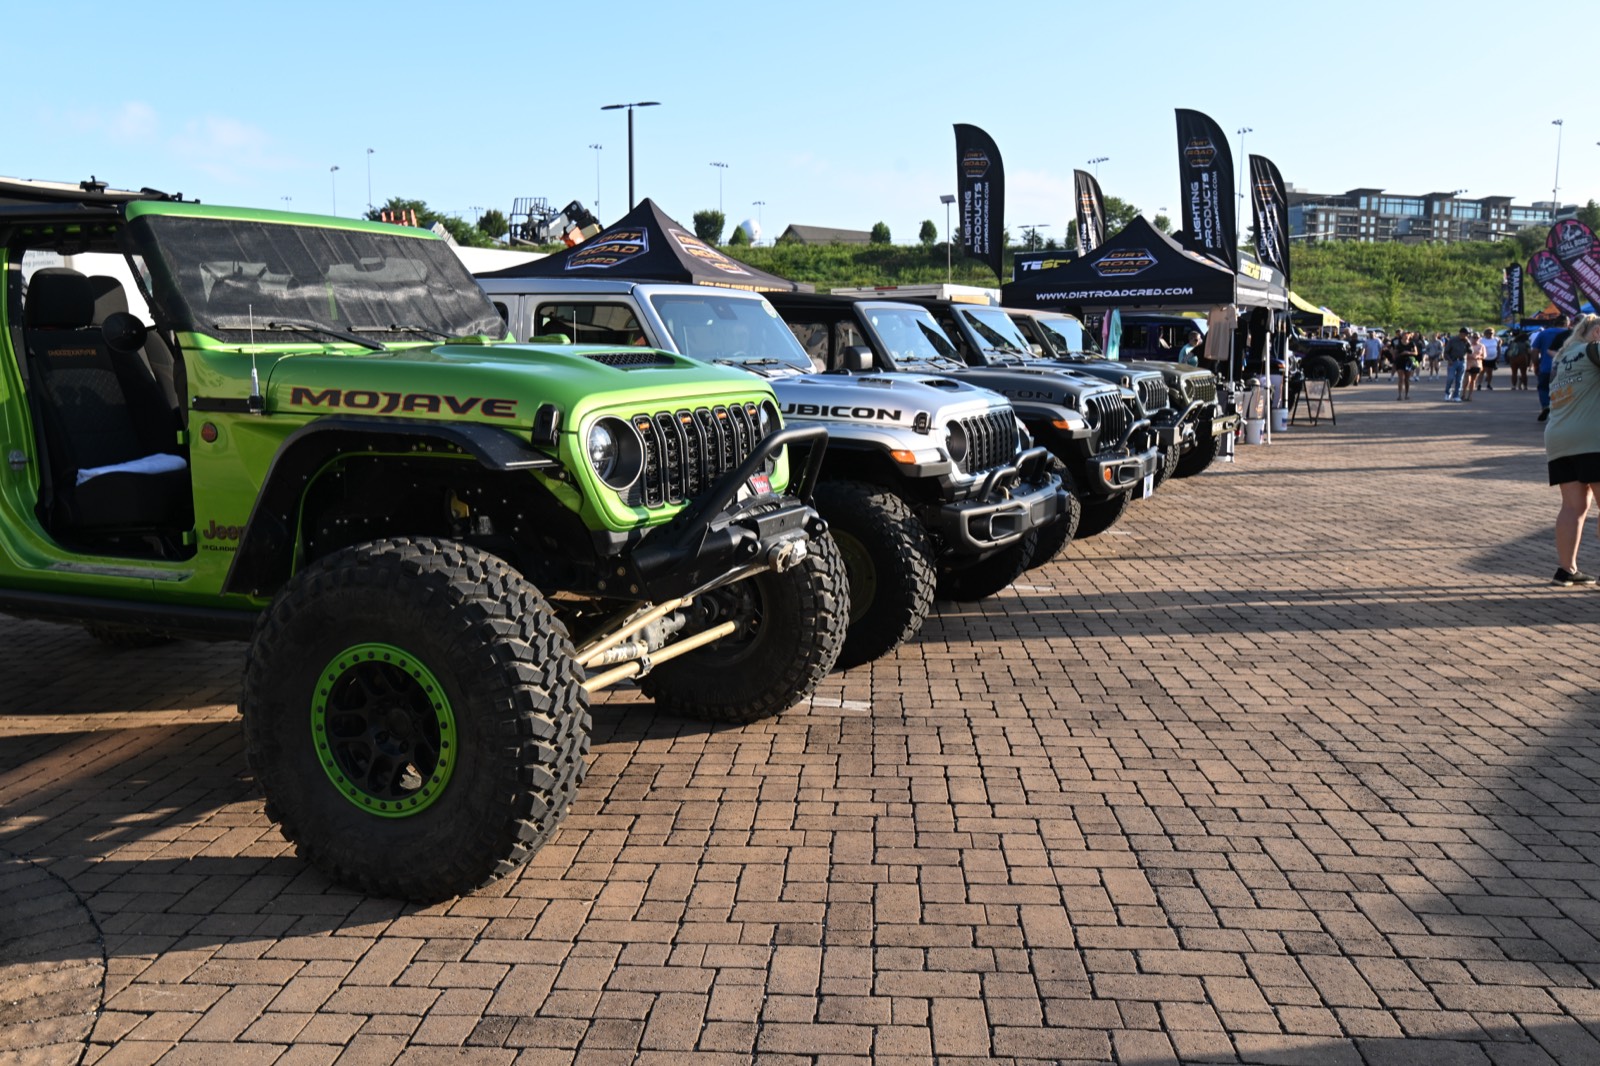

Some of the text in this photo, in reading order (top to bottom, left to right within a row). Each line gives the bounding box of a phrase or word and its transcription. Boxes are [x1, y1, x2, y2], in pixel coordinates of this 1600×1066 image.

[1191, 181, 1202, 240] LIGHTING
[1202, 172, 1213, 249] PRODUCTS
[974, 182, 982, 254] PRODUCTS
[599, 232, 642, 244] DIRT
[576, 244, 640, 257] ROAD
[1560, 242, 1573, 252] FULL
[571, 257, 618, 266] CRED
[1582, 254, 1596, 267] FOOT
[1571, 258, 1600, 292] MIRROR
[1035, 287, 1194, 300] WWW.DIRTROADCRED.COM
[1543, 281, 1559, 293] FOOT
[290, 386, 519, 419] MOJAVE
[779, 402, 902, 421] UBICON
